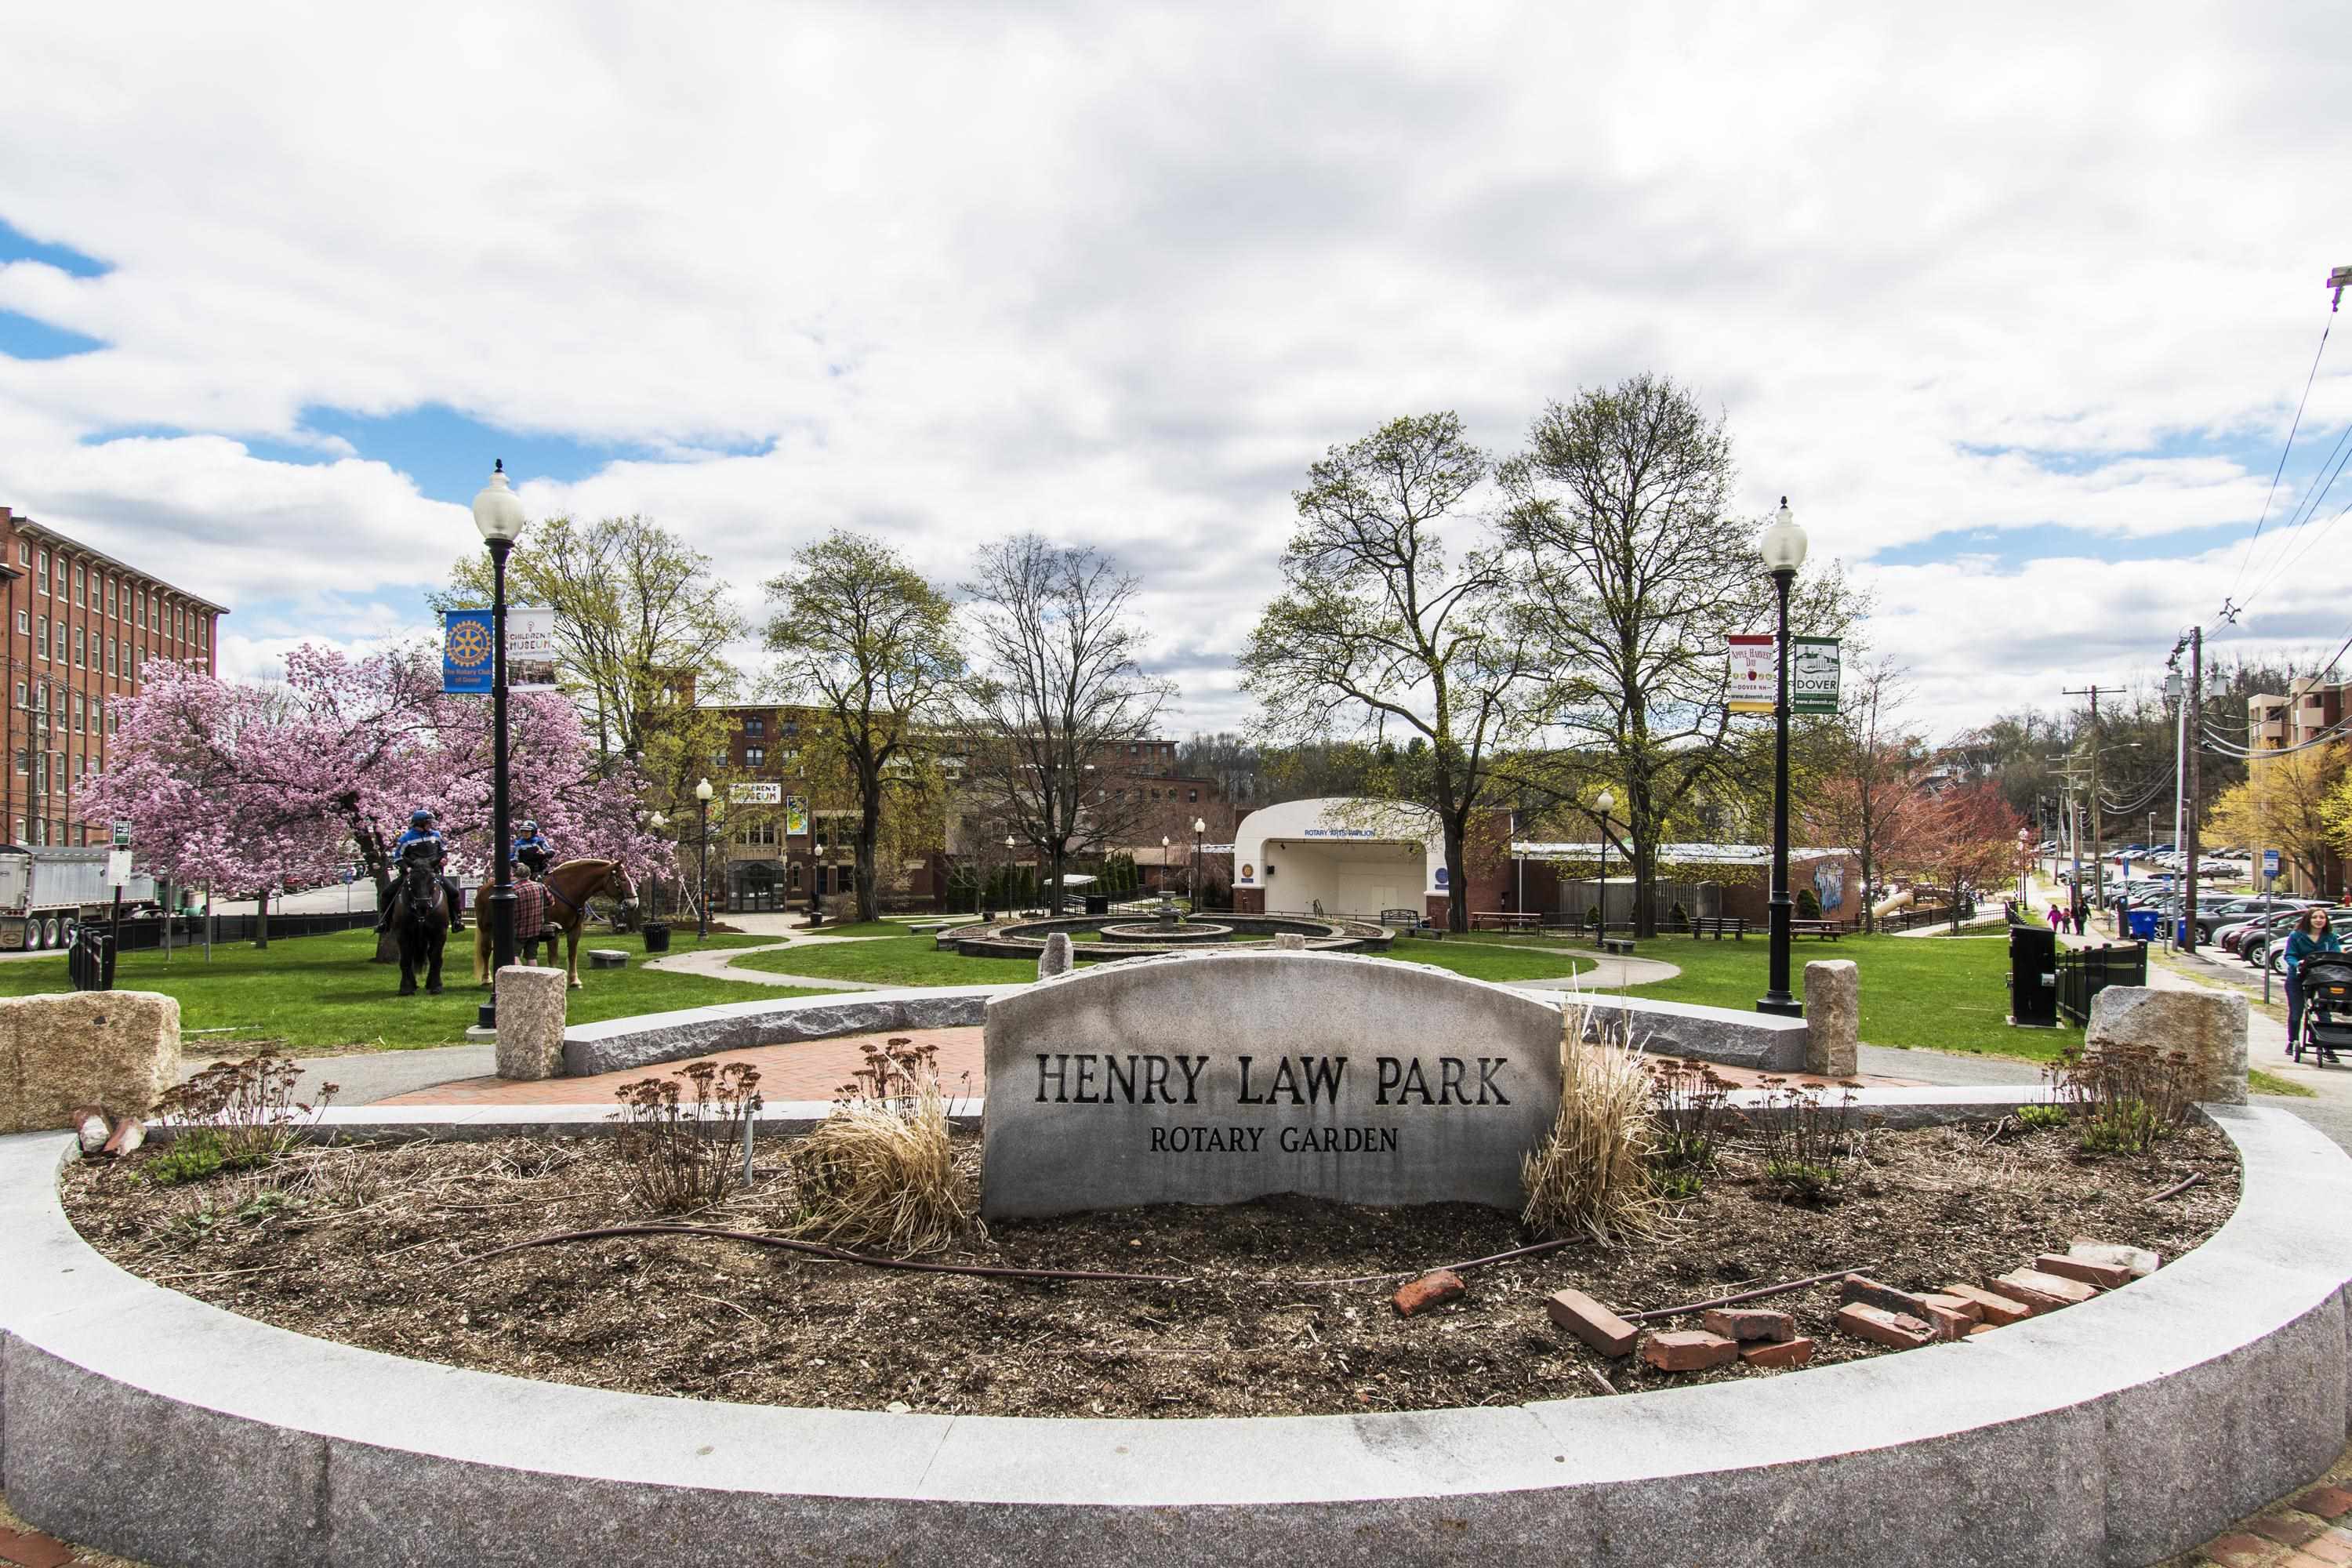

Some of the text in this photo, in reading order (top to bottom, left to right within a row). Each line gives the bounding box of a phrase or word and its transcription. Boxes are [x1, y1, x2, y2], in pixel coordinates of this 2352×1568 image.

[510, 640, 550, 650] MUSEUM
[1797, 680, 1836, 689] DOVER
[1035, 1053, 1511, 1106] HENRY LAW PARK
[1150, 1127, 1399, 1152] ROTARY GARDEN
